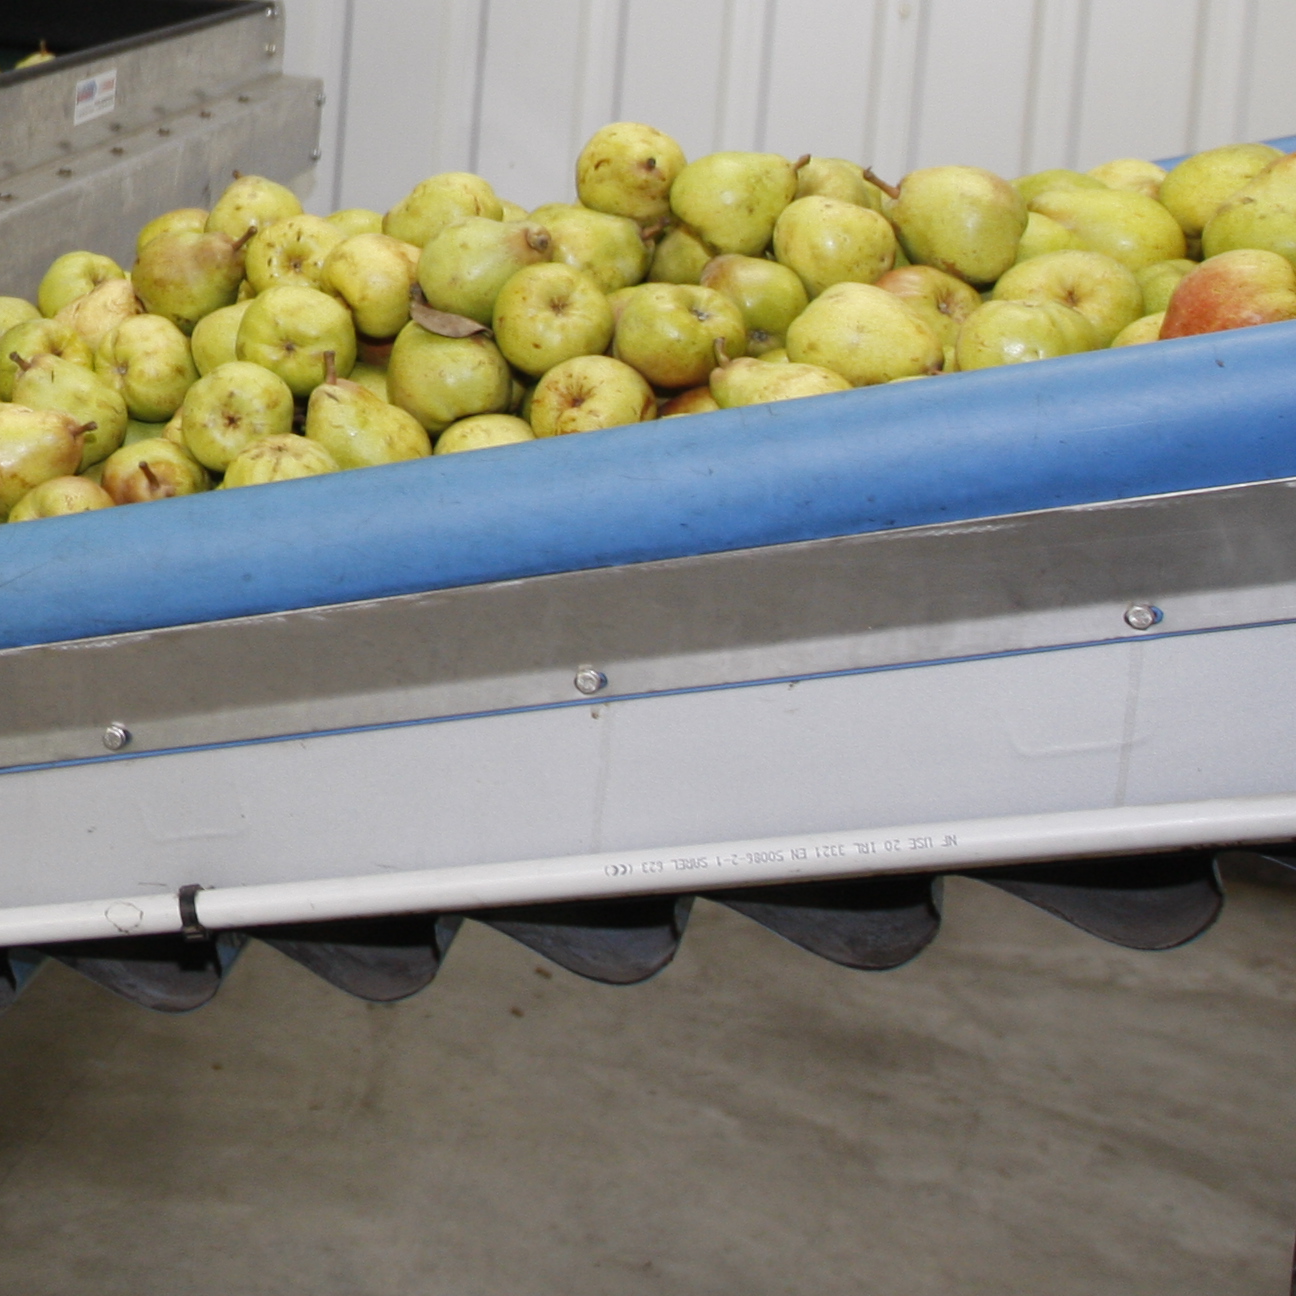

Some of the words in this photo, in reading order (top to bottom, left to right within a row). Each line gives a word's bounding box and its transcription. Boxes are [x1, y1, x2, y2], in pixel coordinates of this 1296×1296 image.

[884, 839, 900, 852] 20
[791, 847, 806, 860] EN
[671, 857, 708, 871] SAREL
